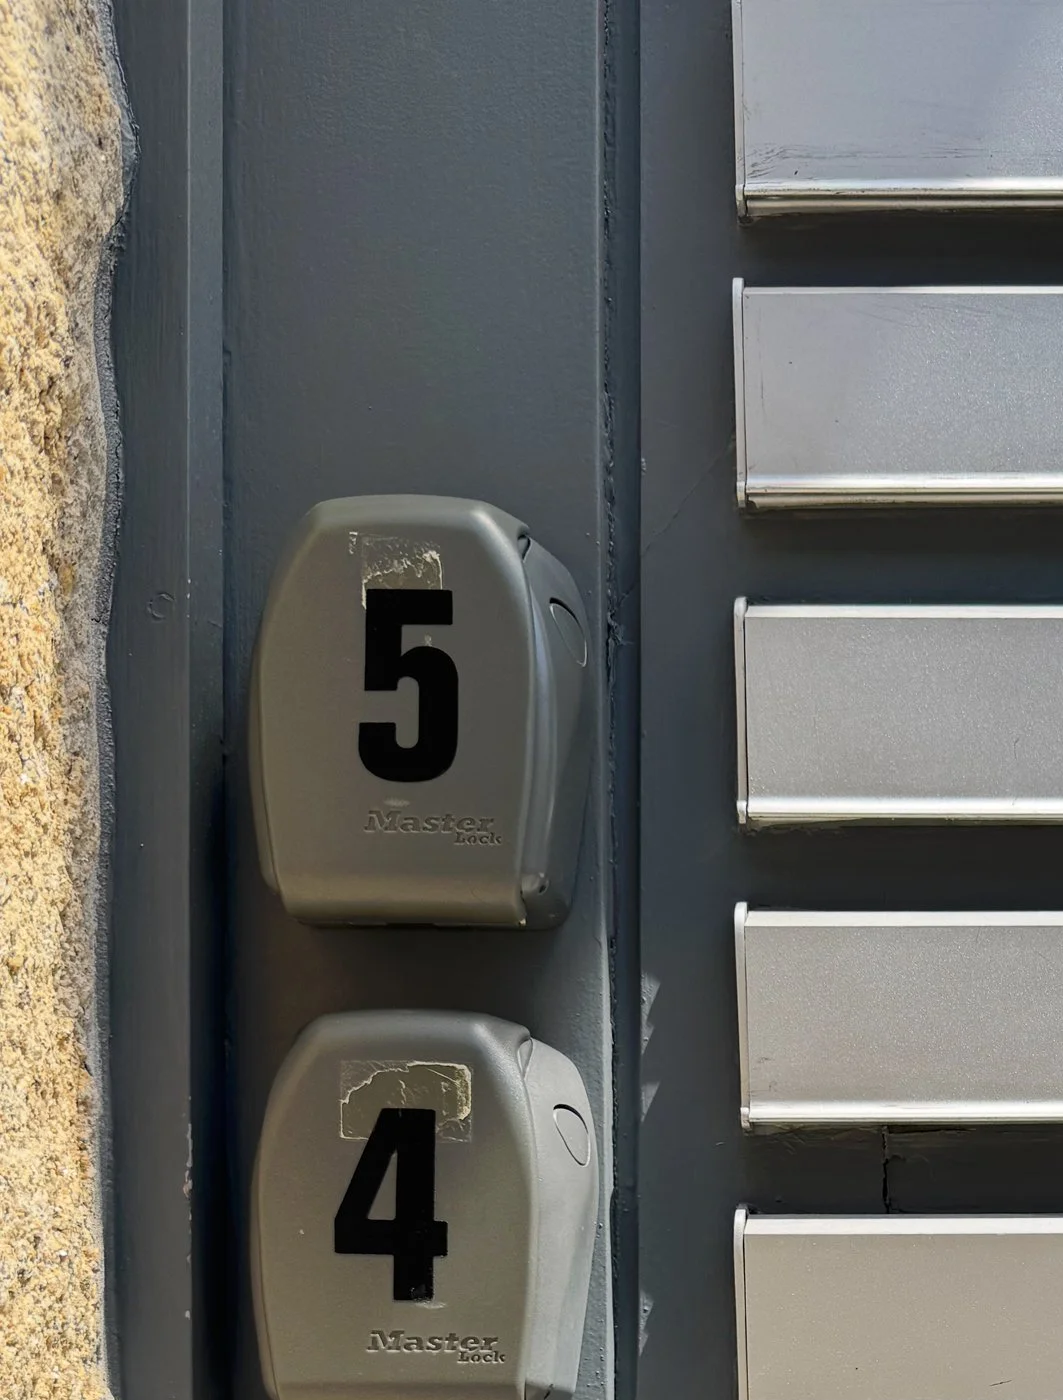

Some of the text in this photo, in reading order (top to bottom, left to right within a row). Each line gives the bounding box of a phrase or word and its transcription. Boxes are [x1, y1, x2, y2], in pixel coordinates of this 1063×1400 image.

[358, 589, 458, 782] 5
[364, 809, 495, 833] Master
[453, 832, 502, 846] Lock
[334, 1108, 448, 1301] 4
[366, 1329, 499, 1352] Master
[457, 1351, 506, 1364] Lock
